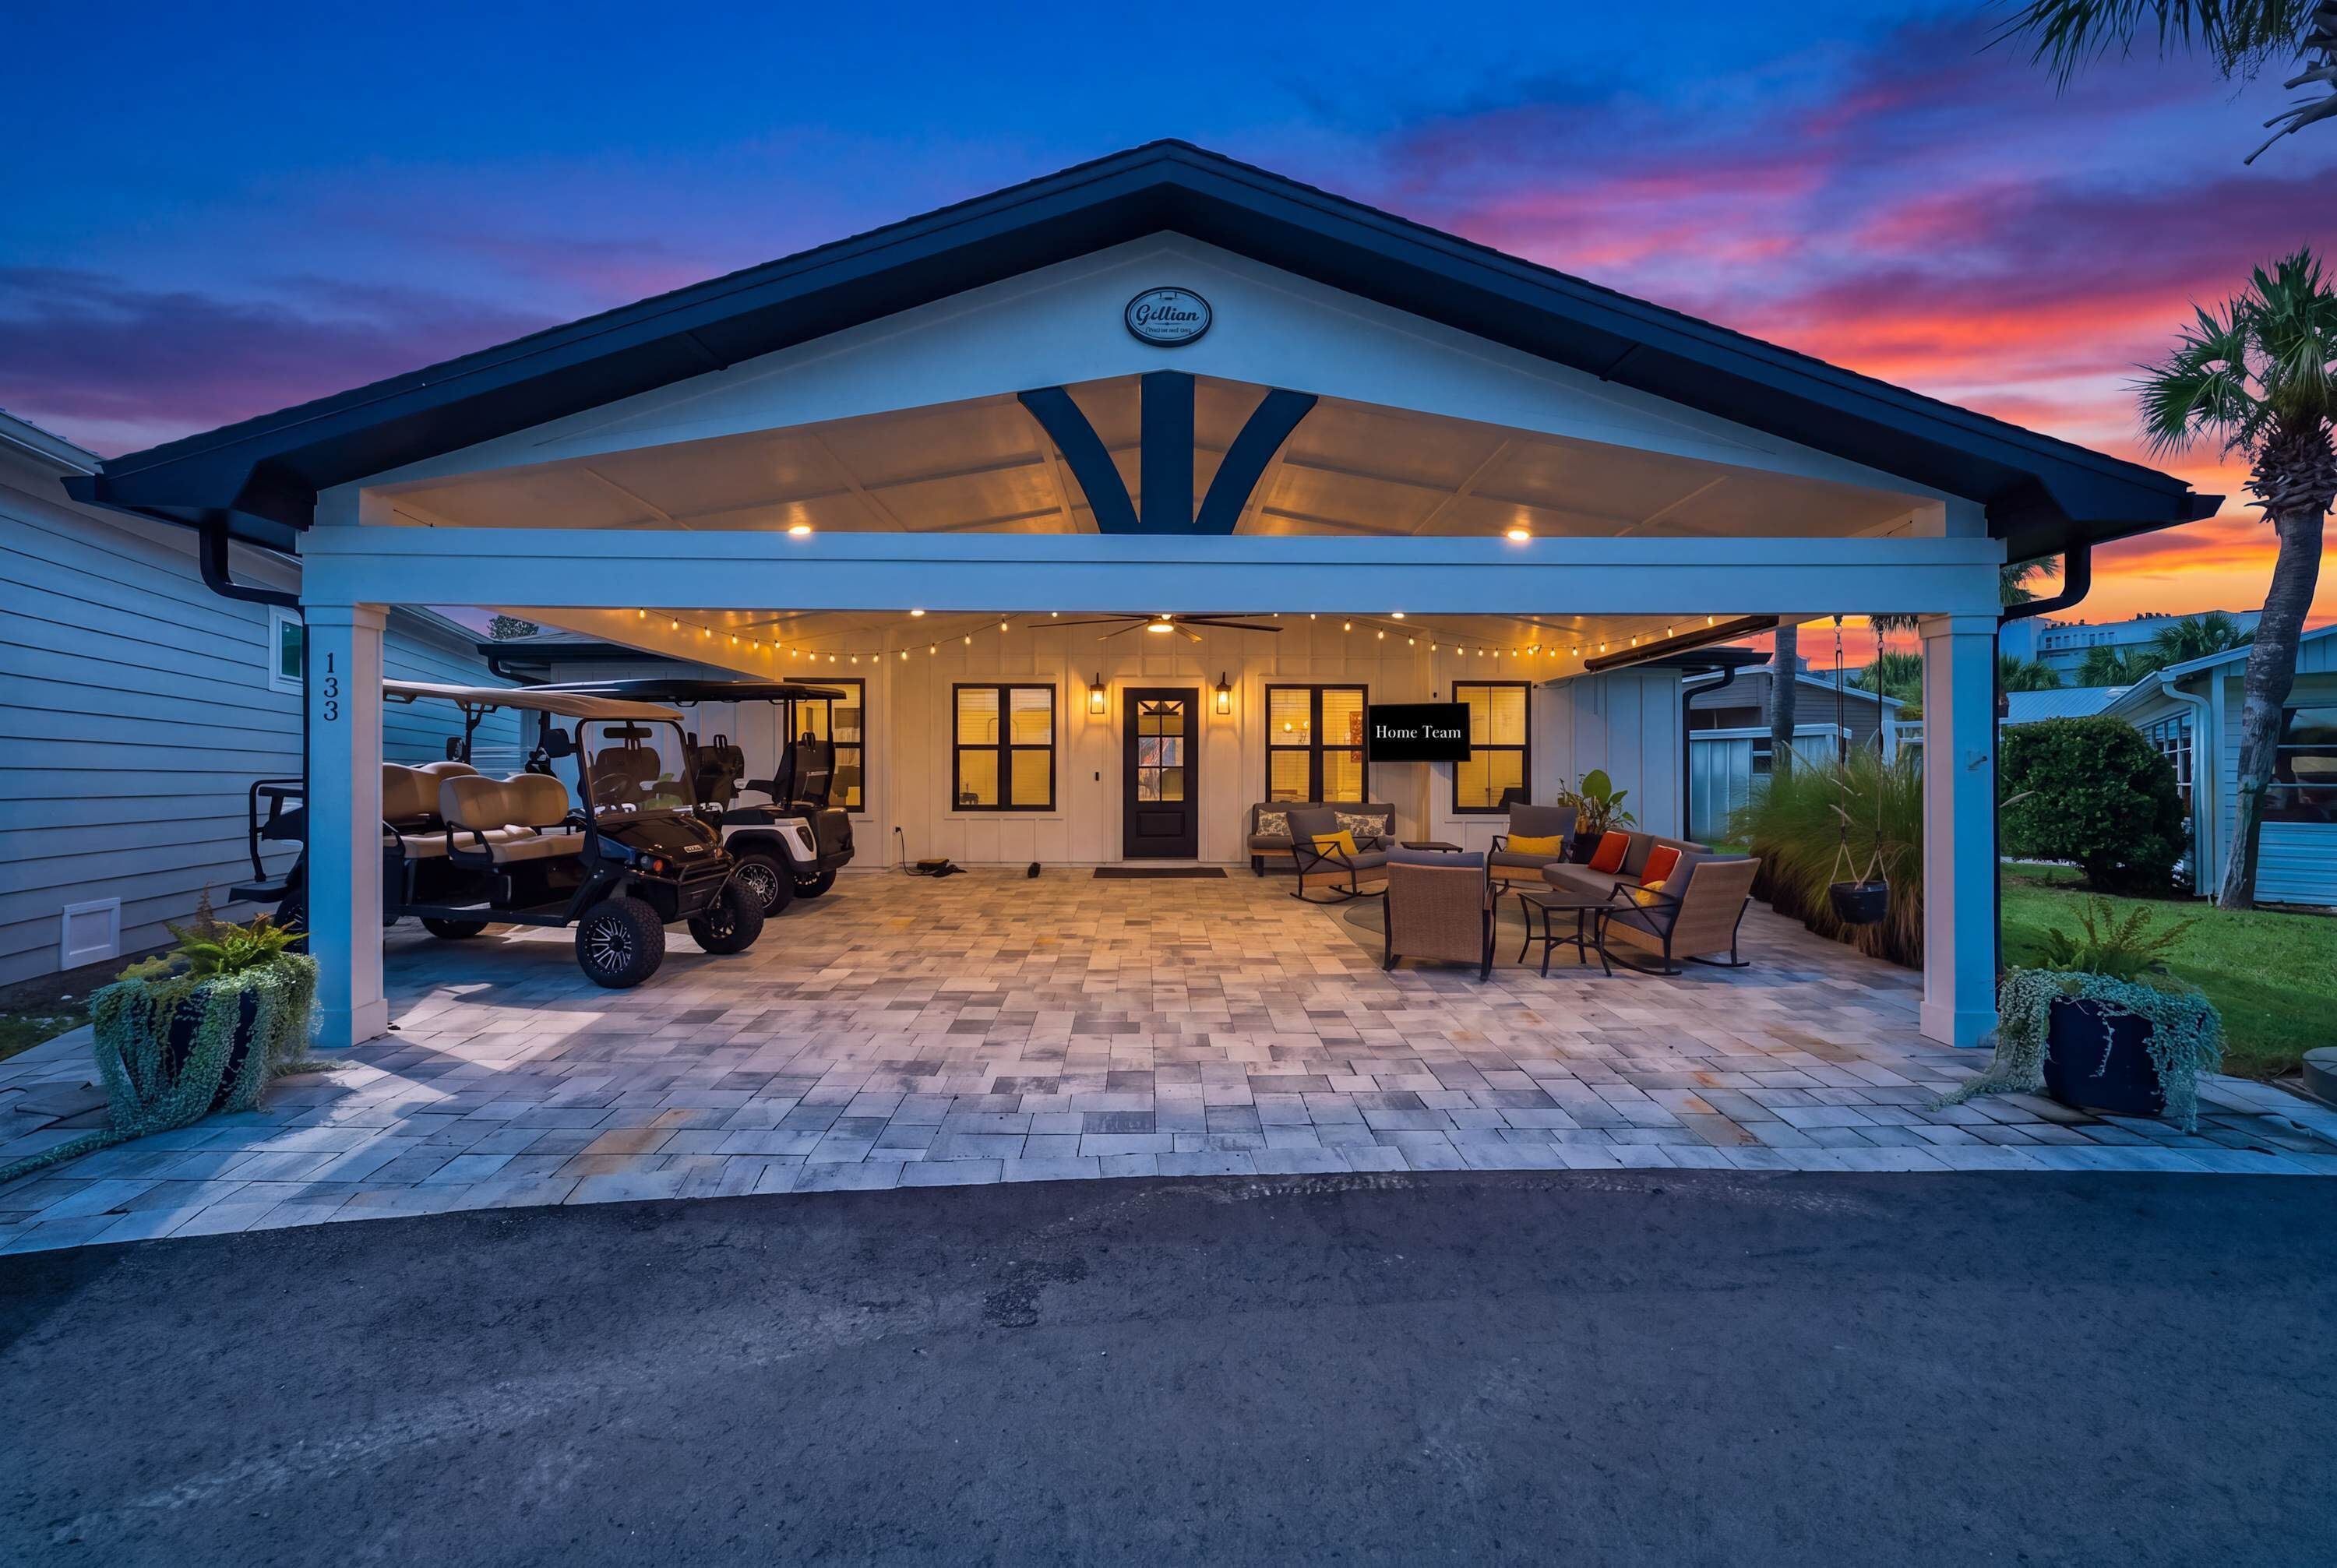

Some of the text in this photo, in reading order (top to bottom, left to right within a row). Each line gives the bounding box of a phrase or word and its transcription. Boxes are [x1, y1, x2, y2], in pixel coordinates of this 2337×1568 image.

[1136, 304, 1200, 326] Gillian
[323, 652, 339, 721] 133
[1376, 725, 1461, 738] Home Team
